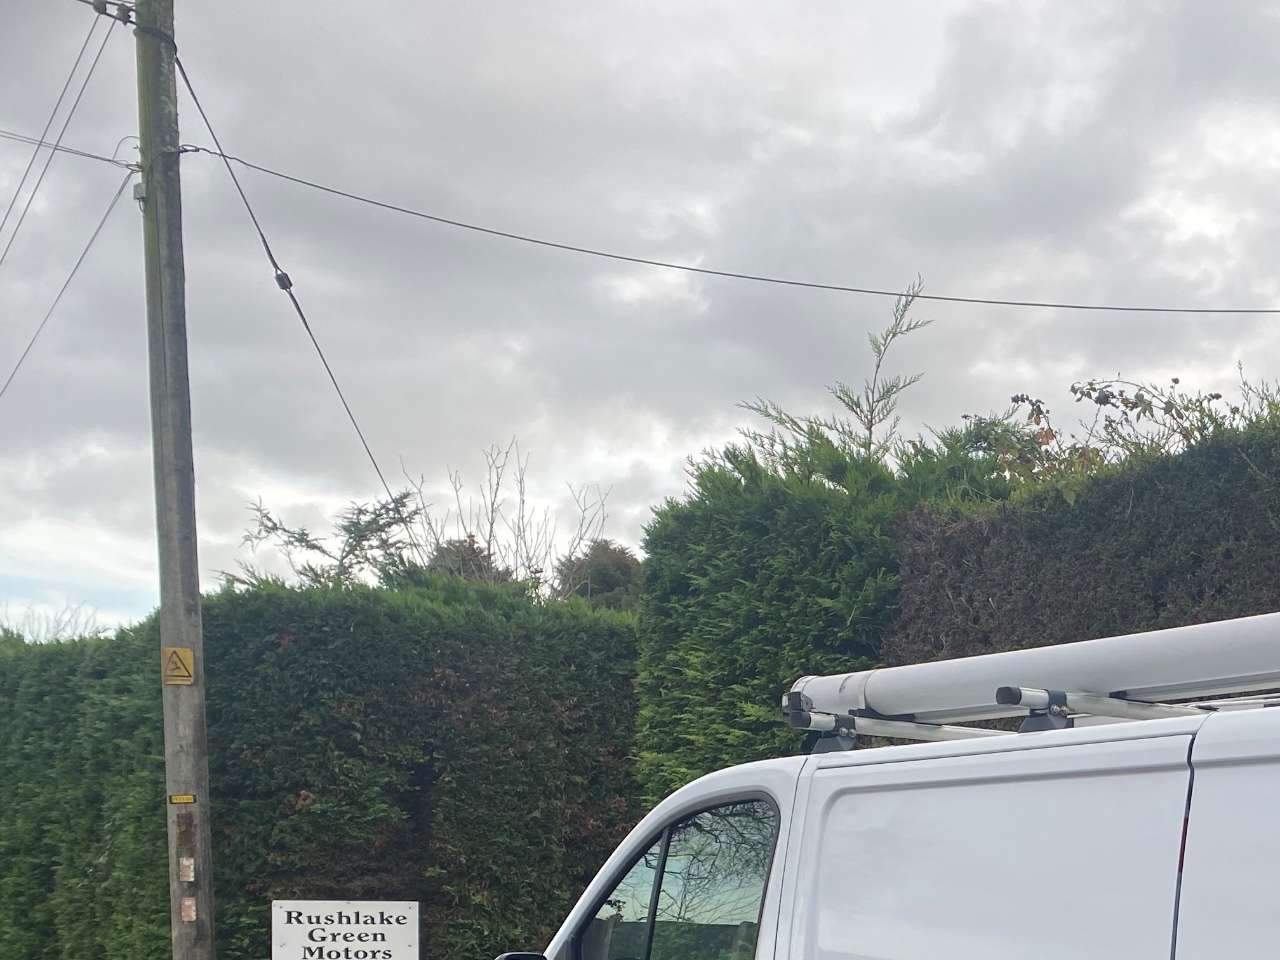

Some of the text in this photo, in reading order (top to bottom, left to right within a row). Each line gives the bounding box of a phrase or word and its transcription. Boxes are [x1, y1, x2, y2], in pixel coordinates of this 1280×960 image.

[284, 910, 408, 925] Rushlake
[307, 927, 386, 942] Green
[302, 945, 393, 960] Motors
